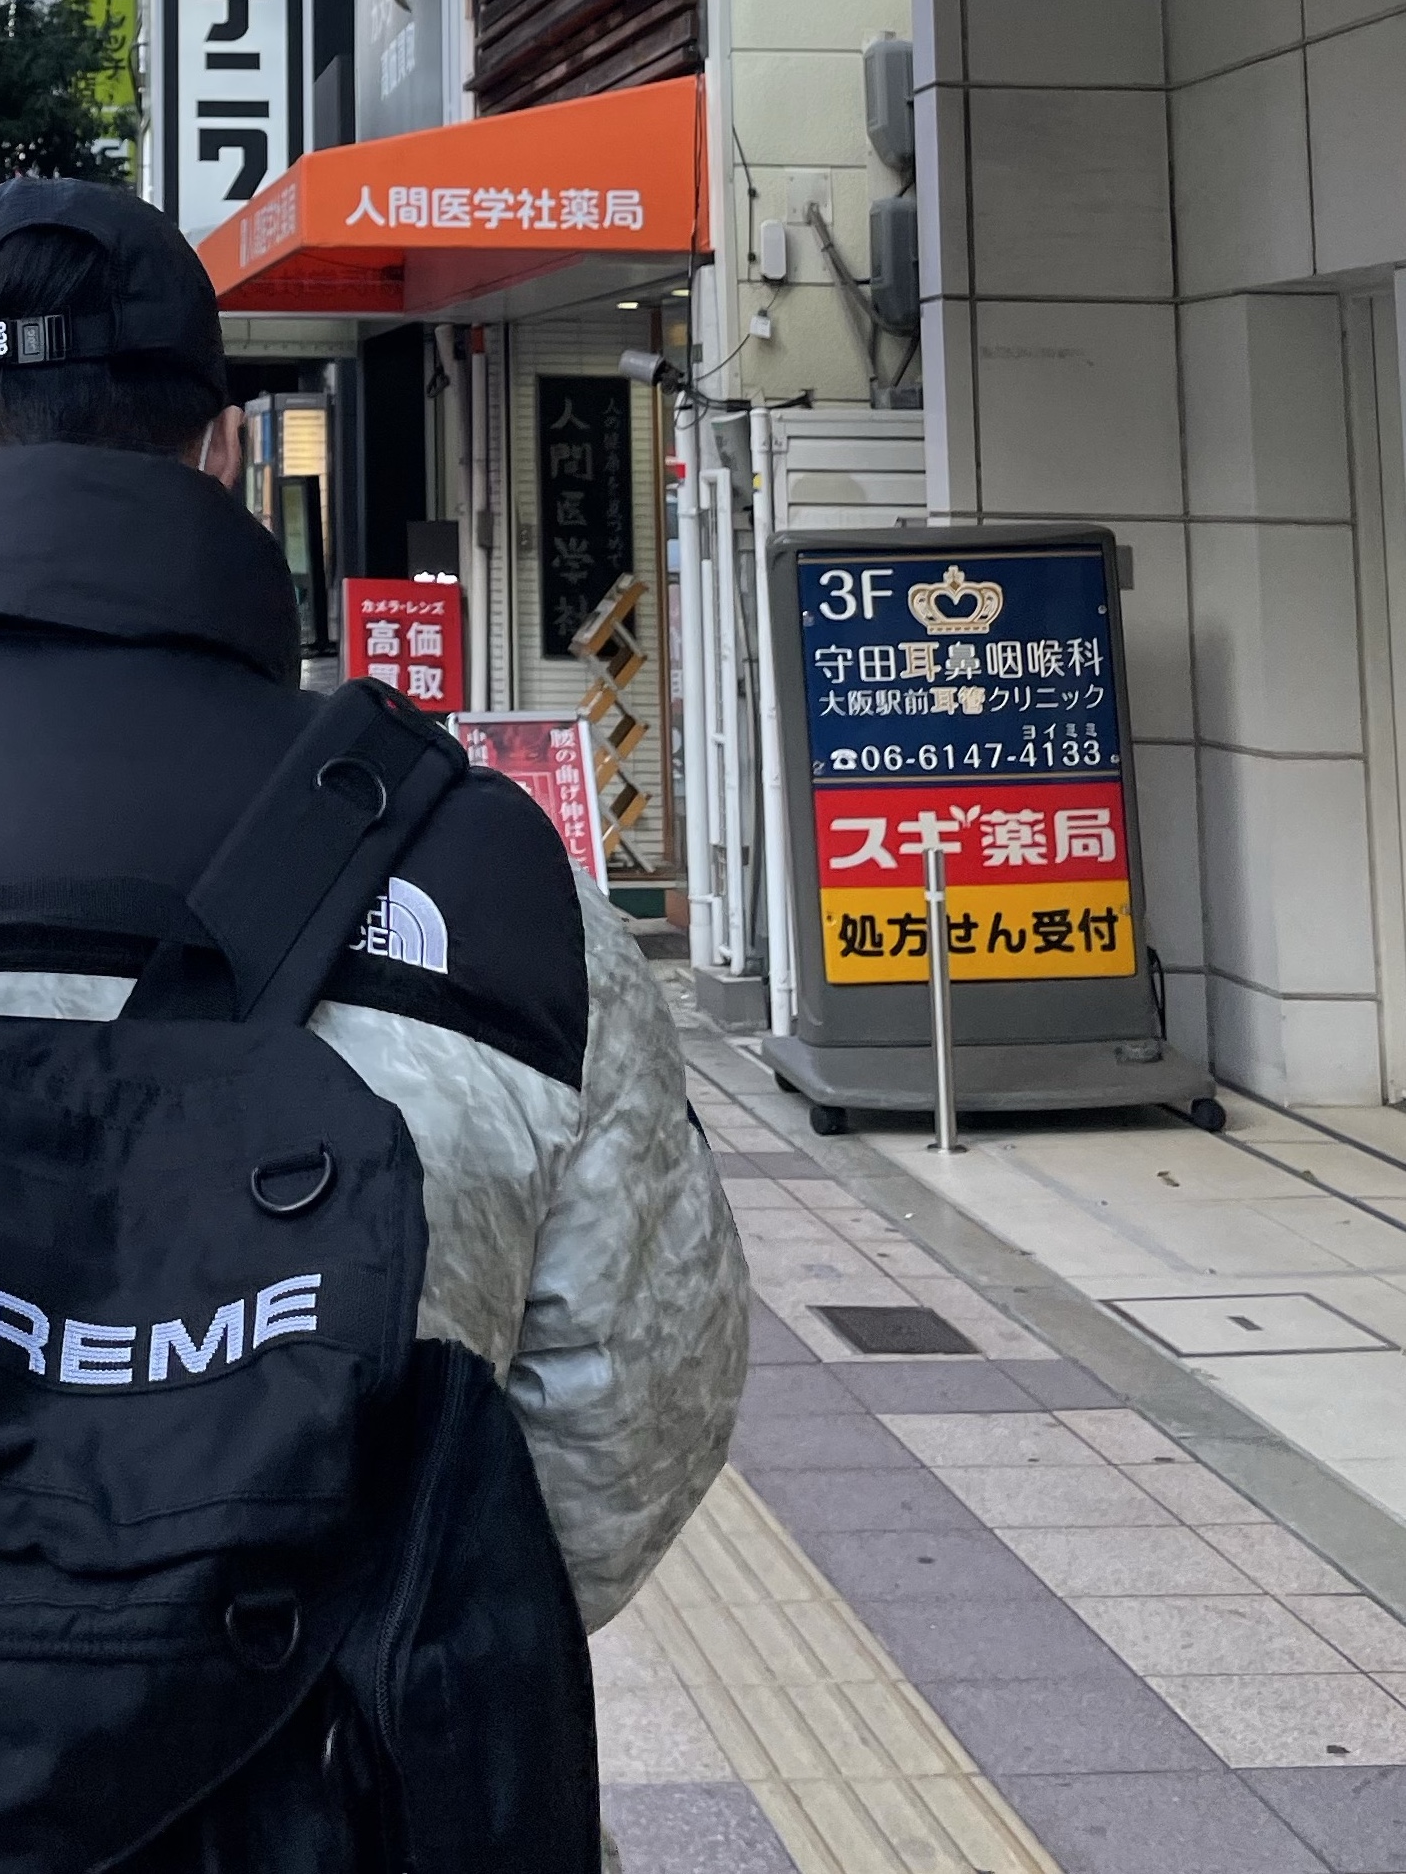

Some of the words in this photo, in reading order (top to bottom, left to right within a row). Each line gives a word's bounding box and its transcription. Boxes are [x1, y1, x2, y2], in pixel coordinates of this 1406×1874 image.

[344, 184, 644, 231] 人間医学社薬局
[360, 598, 446, 615] カメラ・レンズ
[819, 568, 894, 621] 3F
[365, 619, 444, 658] 高価
[813, 636, 1105, 685] 守田耳鼻咽喉科
[818, 682, 1105, 717] 大阪駅前耳管クリニック
[1022, 722, 1098, 741] ヨイミミ
[860, 739, 1102, 772] 06-6147-4133
[828, 804, 1117, 870] スギ薬局
[838, 906, 1120, 959] 処方せん受付
